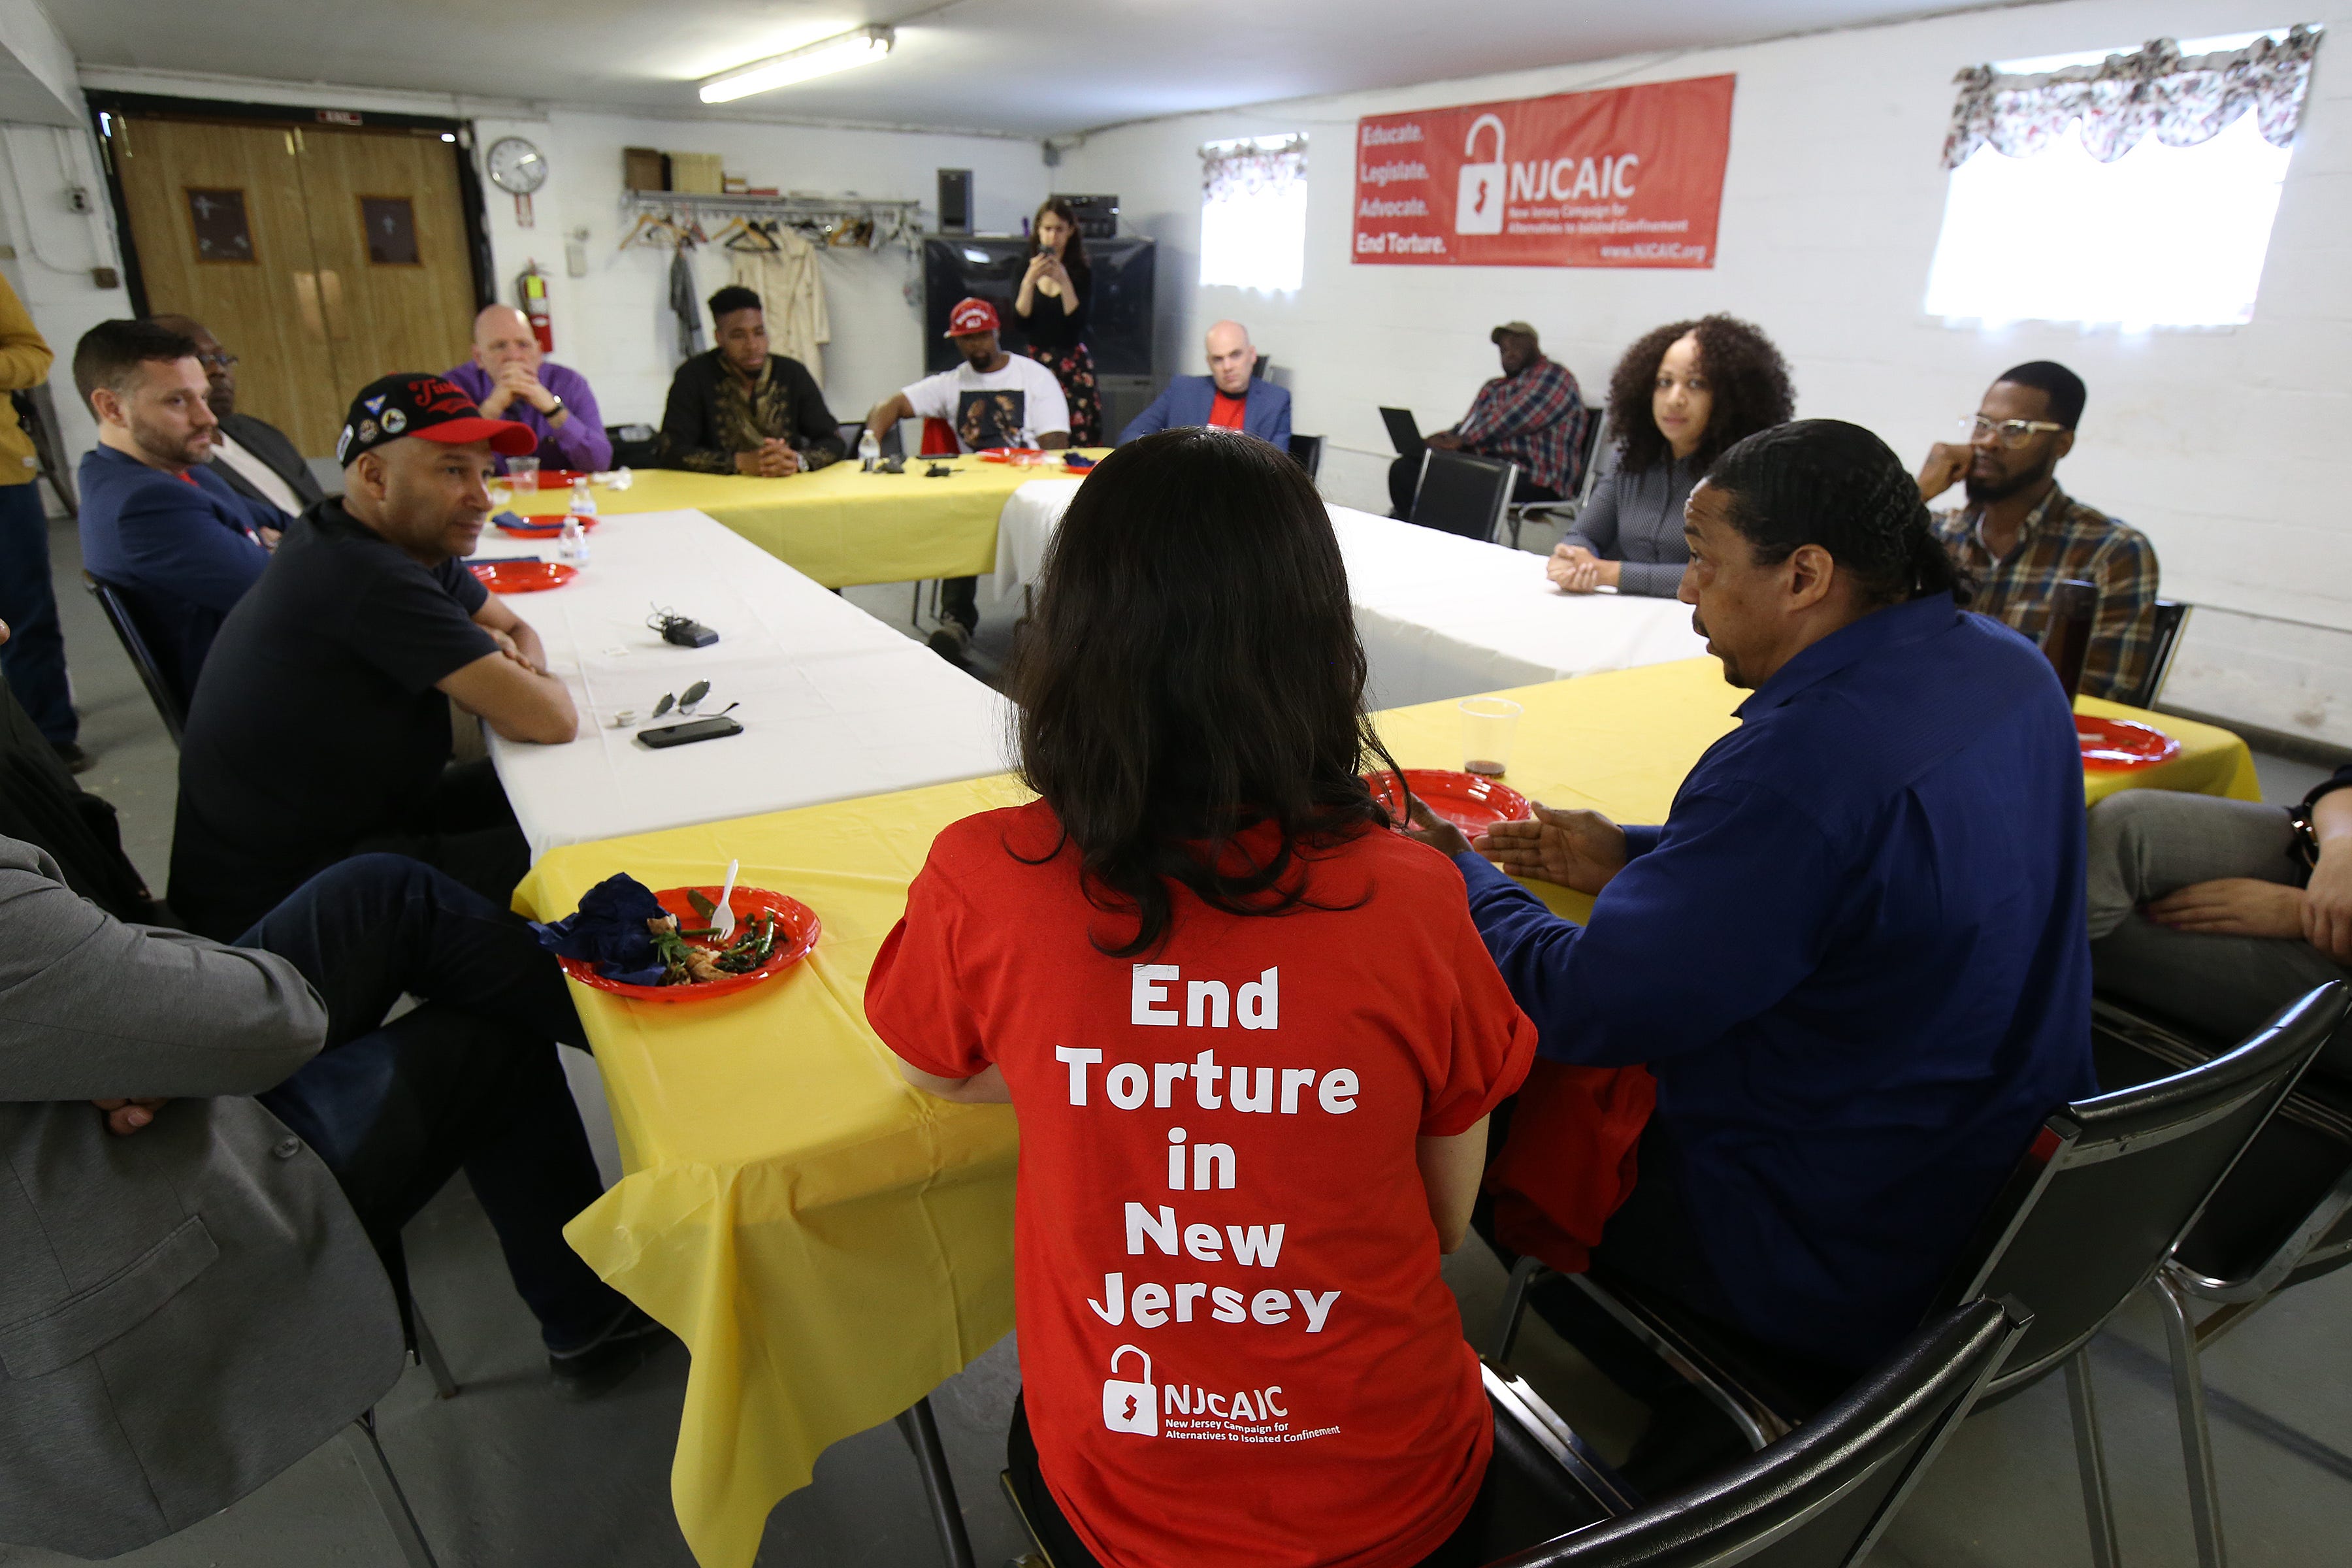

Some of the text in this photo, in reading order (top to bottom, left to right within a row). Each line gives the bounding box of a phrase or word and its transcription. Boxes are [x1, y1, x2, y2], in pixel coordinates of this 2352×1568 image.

[1362, 122, 1424, 146] Educate.
[1361, 160, 1429, 187] Legislate.
[1509, 154, 1639, 201] NJCAIC
[1358, 197, 1429, 218] Advocate.
[1357, 232, 1447, 254] End Torture.
[1601, 242, 1707, 262] www.NJCAIC.org
[1132, 963, 1279, 1030] End
[1056, 1045, 1360, 1115] Torture
[1168, 1127, 1235, 1190] in
[1125, 1202, 1285, 1267] New
[1087, 1272, 1341, 1333] Jersey
[1164, 1384, 1288, 1422] NJCAIC
[1166, 1419, 1289, 1435] New Jersey Campaign for
[1166, 1425, 1341, 1443] Alternatives to Isolated Confinement
